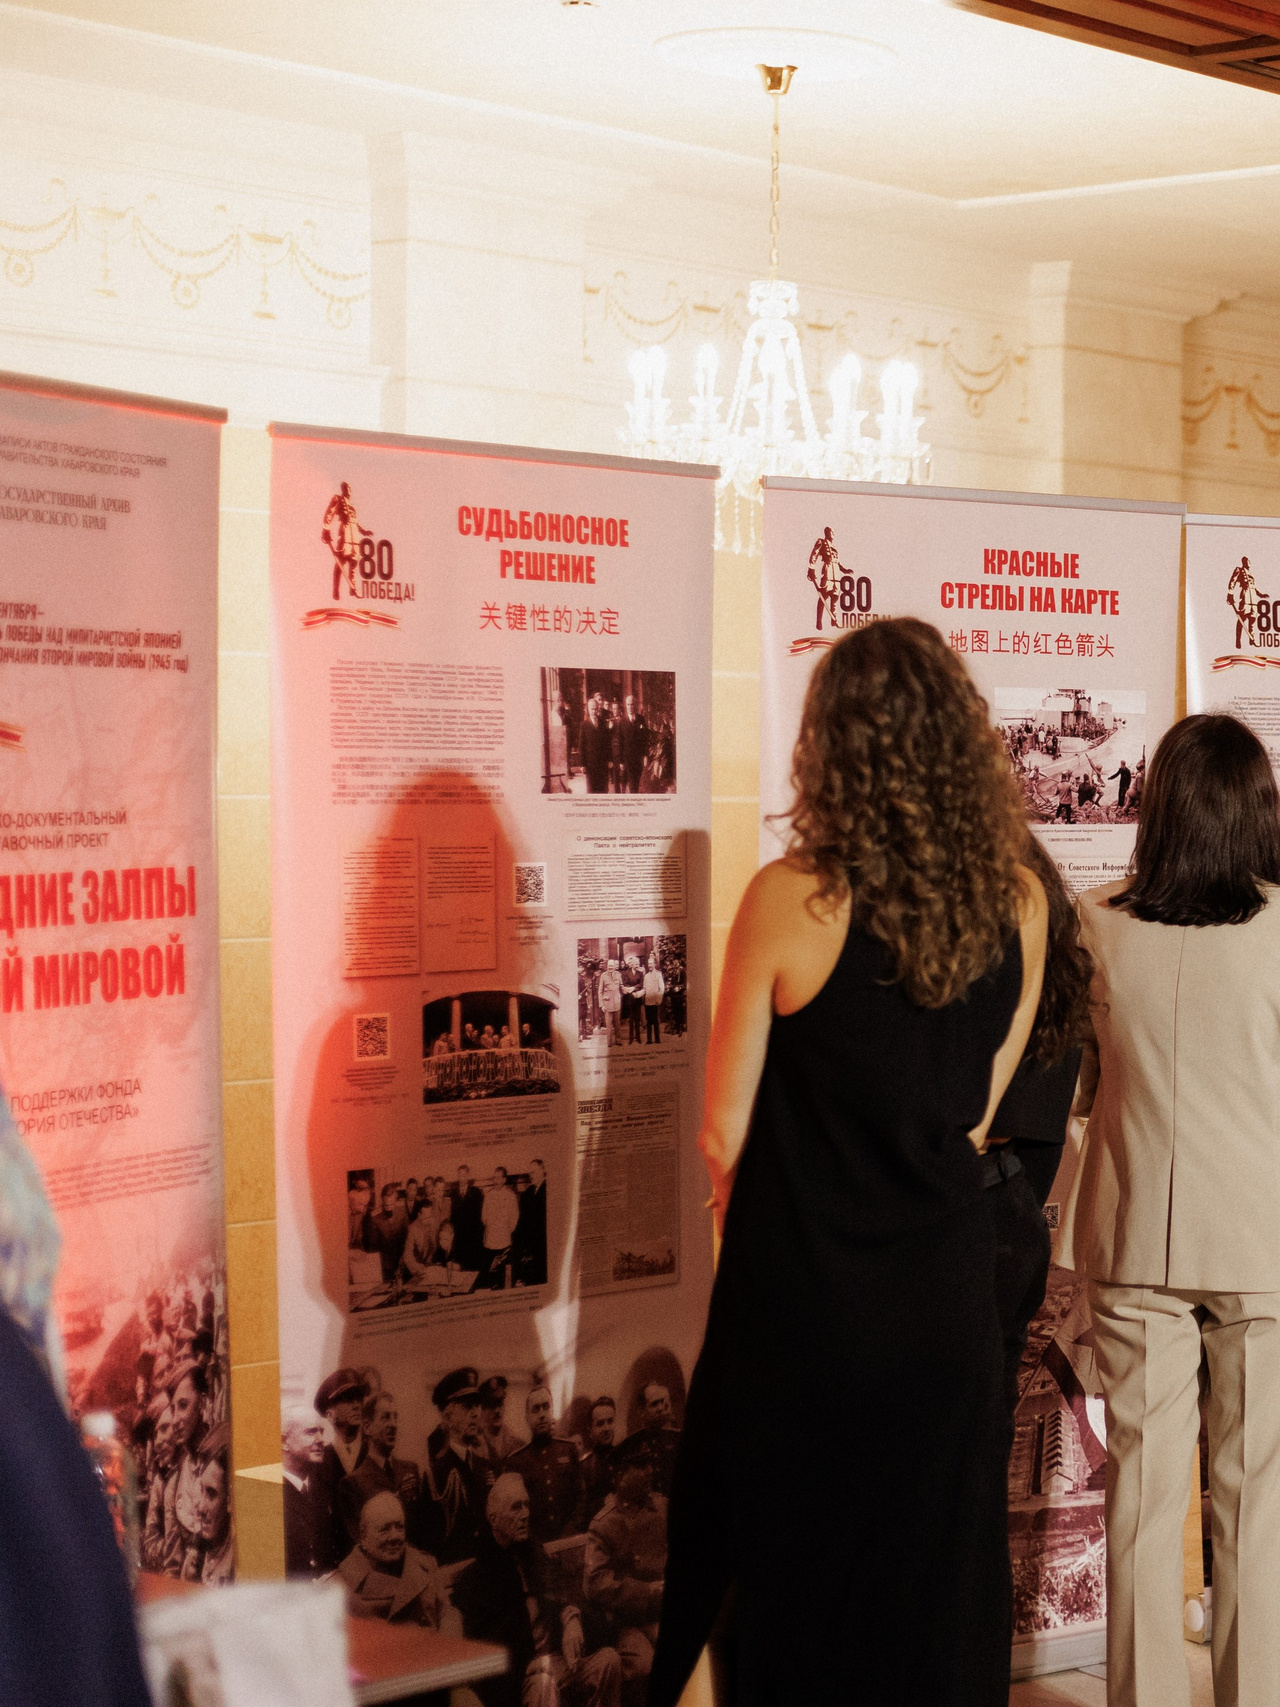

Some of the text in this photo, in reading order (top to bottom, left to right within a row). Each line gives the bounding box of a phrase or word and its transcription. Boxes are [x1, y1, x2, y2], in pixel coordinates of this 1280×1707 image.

[0, 435, 31, 448] АПИСИ
[0, 451, 58, 468] АВИТЕЛЬСТВА
[101, 497, 131, 513] АРХИВ
[82, 514, 107, 530] КРАЯ
[458, 506, 628, 547] СУДЬБОНОСНОЕ
[359, 538, 393, 580] 80
[500, 550, 595, 584] РЕШЕНИЕ
[984, 549, 1079, 578] КРАСНЫЕ
[361, 580, 415, 603] ПОБЕДА!
[840, 576, 871, 612] 80
[941, 582, 1119, 615] СТРЕЛЫ НА КАРТЕ
[480, 602, 619, 635] 关键性的决定
[6, 624, 43, 644] ПОБЕДЫ
[46, 627, 63, 645] НАД
[143, 631, 182, 649] ЯПОНИЕЙ
[949, 629, 1115, 657] 地图上的红色箭头
[41, 646, 74, 666] ВТОРОЙ
[75, 648, 114, 668] МИРОВОЙ
[116, 649, 146, 669] ВОЙНЫ
[0, 830, 109, 851] АВОЧНЫЙ ПРОЕКТ
[1068, 862, 1100, 872] Советского
[81, 866, 196, 925] ЗАЛПЫ
[33, 933, 185, 1010] МИРОВОЙ
[11, 1079, 142, 1114] ПОДДЕРЖКИ ФОНДА
[58, 1103, 139, 1131] ОТЕЧЕСТВА»
